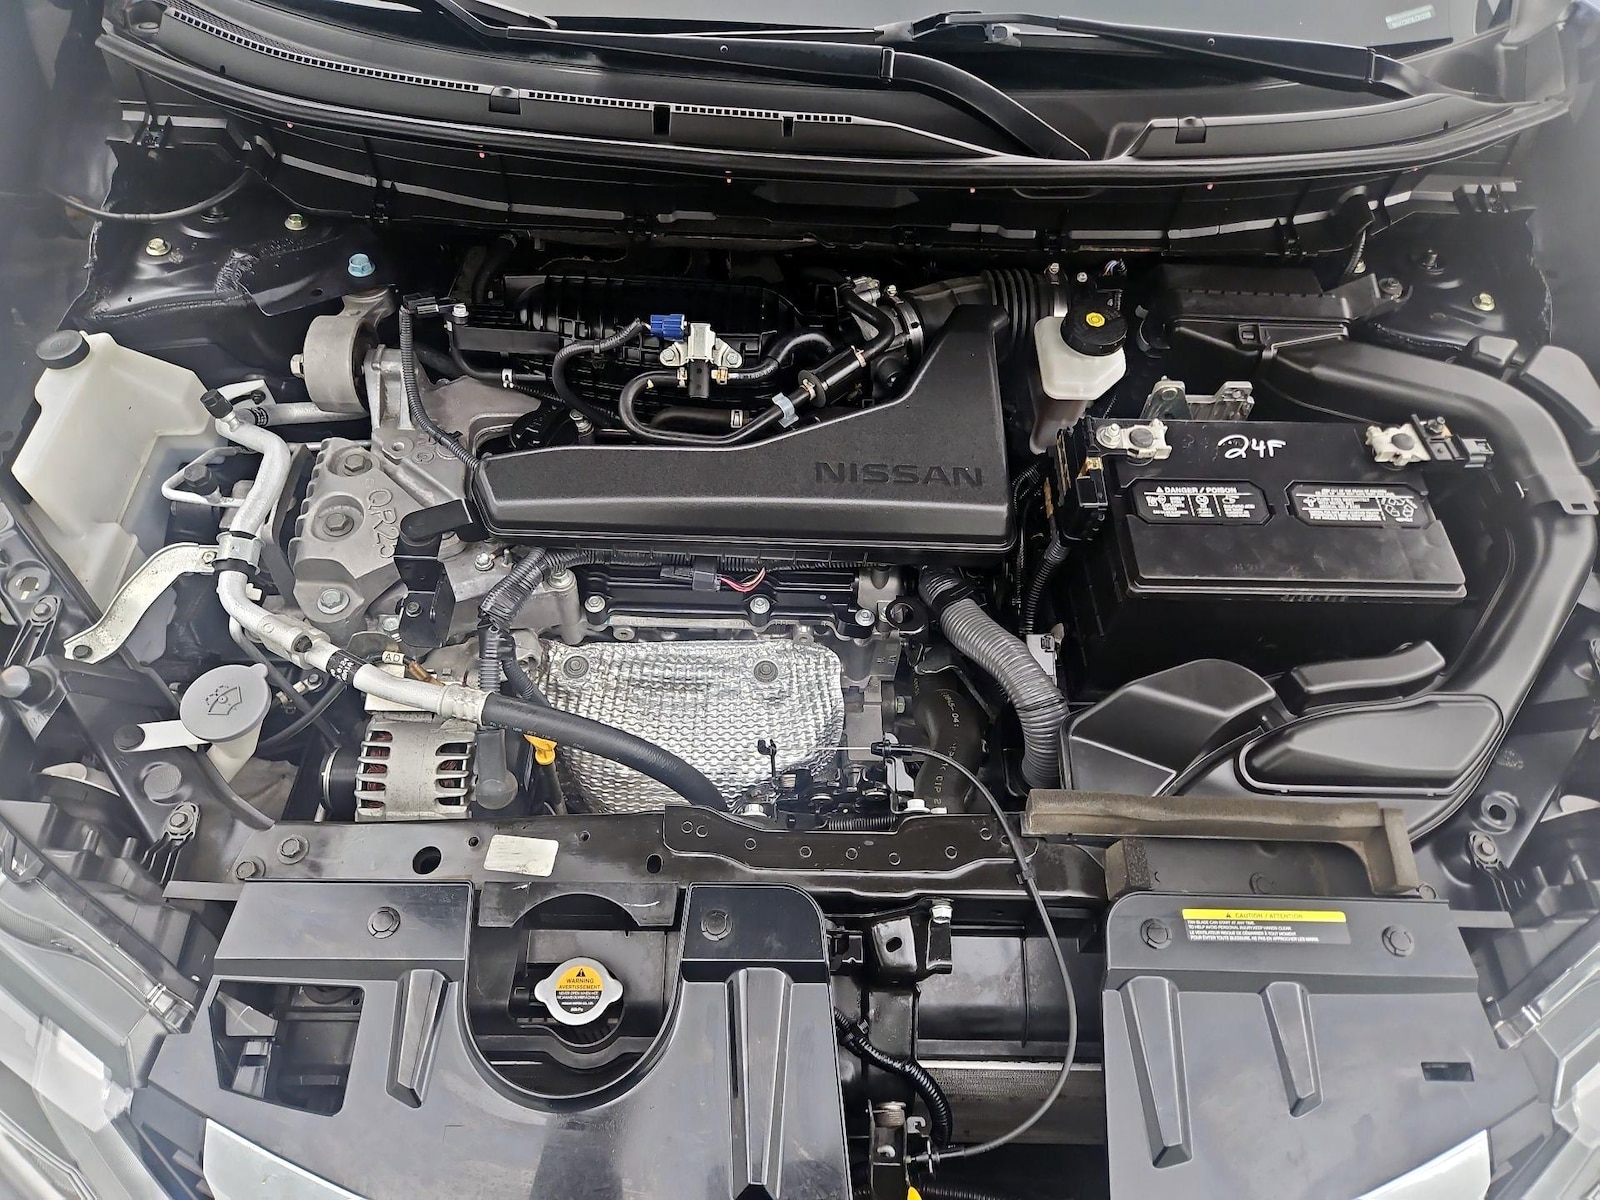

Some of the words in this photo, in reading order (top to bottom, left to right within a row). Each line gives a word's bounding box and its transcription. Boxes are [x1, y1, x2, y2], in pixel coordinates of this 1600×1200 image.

[1218, 434, 1286, 459] 24F
[814, 461, 984, 488] NISSAN
[384, 653, 400, 662] AD
